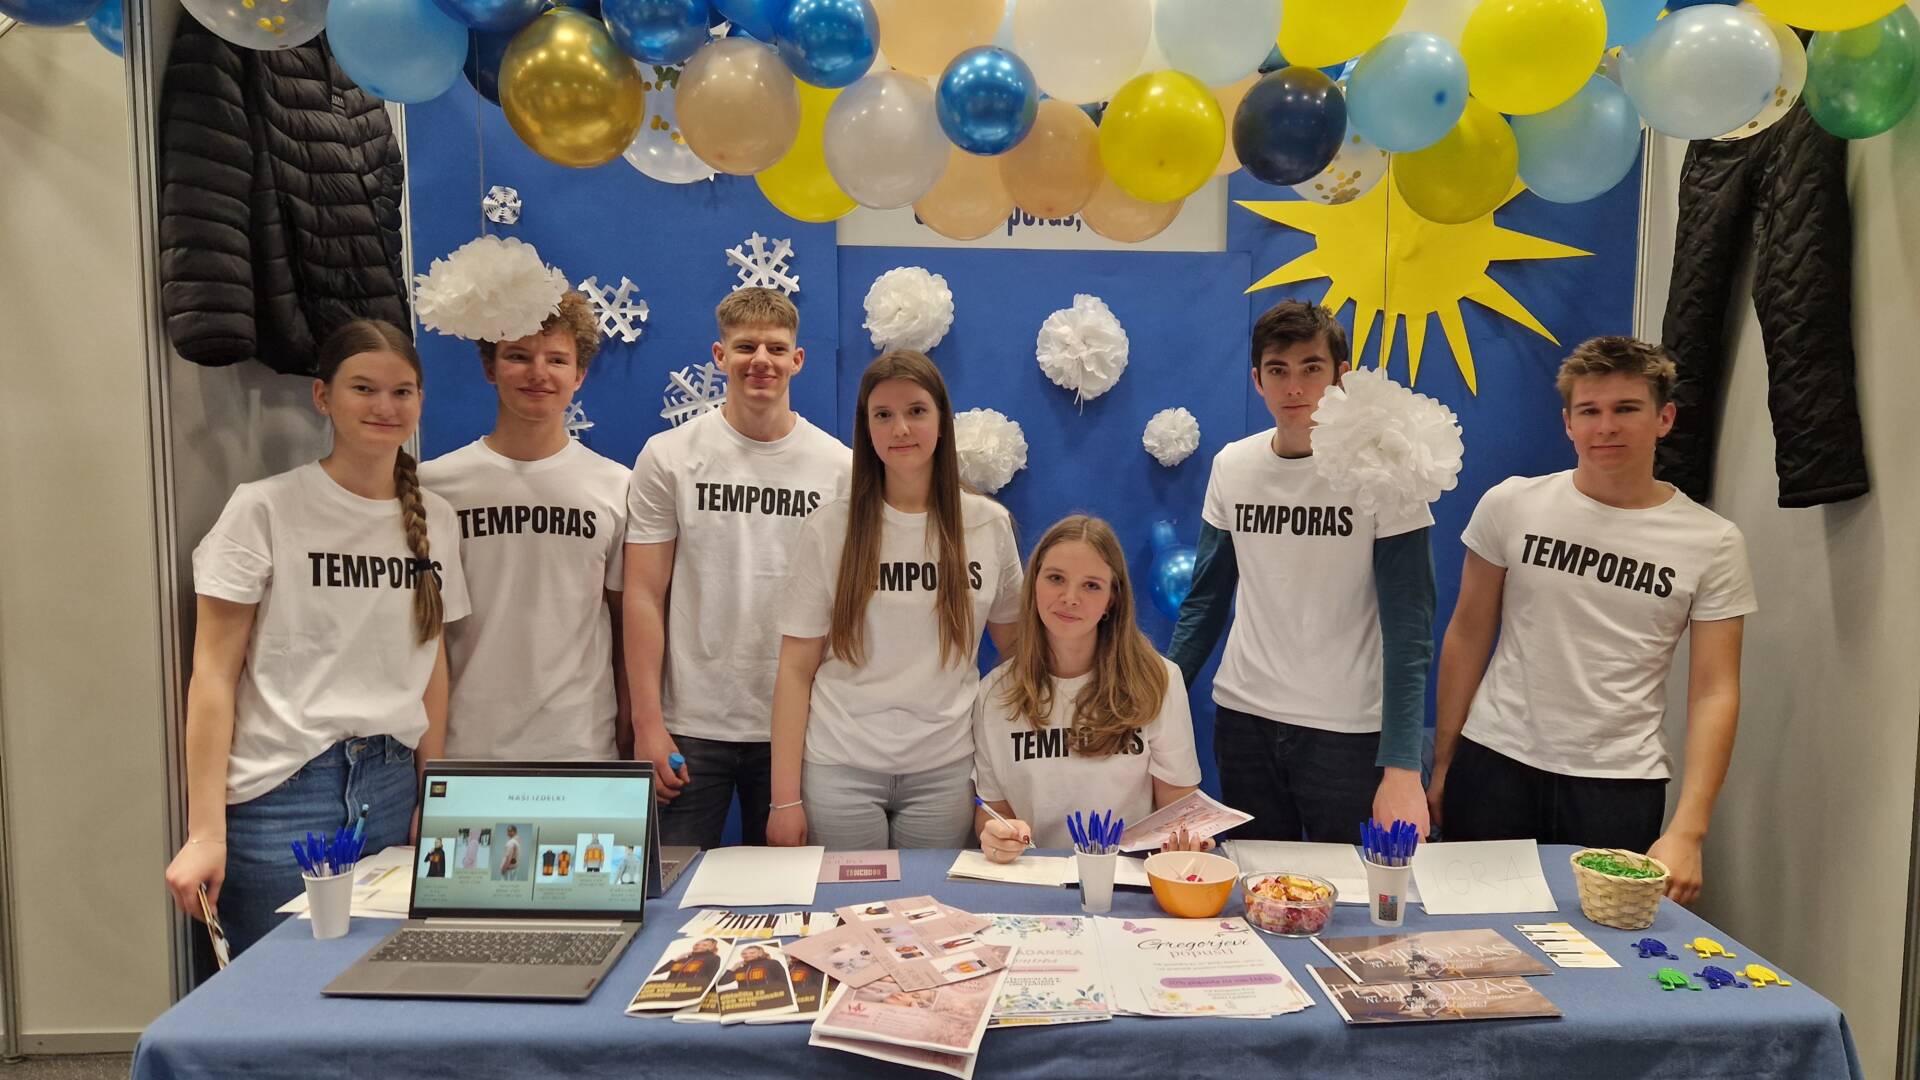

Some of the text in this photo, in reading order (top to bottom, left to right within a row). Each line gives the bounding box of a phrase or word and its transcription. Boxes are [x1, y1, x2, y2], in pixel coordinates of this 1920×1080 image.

[696, 482, 821, 518] TEMPORAS
[457, 505, 597, 540] TEMPORAS
[1235, 503, 1353, 537] TEMPORAS
[307, 552, 443, 592] TEMPORS
[872, 561, 983, 592] MPOS
[1521, 534, 1676, 599] TEMPORAS
[1011, 727, 1145, 762] TEMPS
[1137, 937, 1250, 951] Gregorjevi
[1169, 948, 1235, 960] popusti
